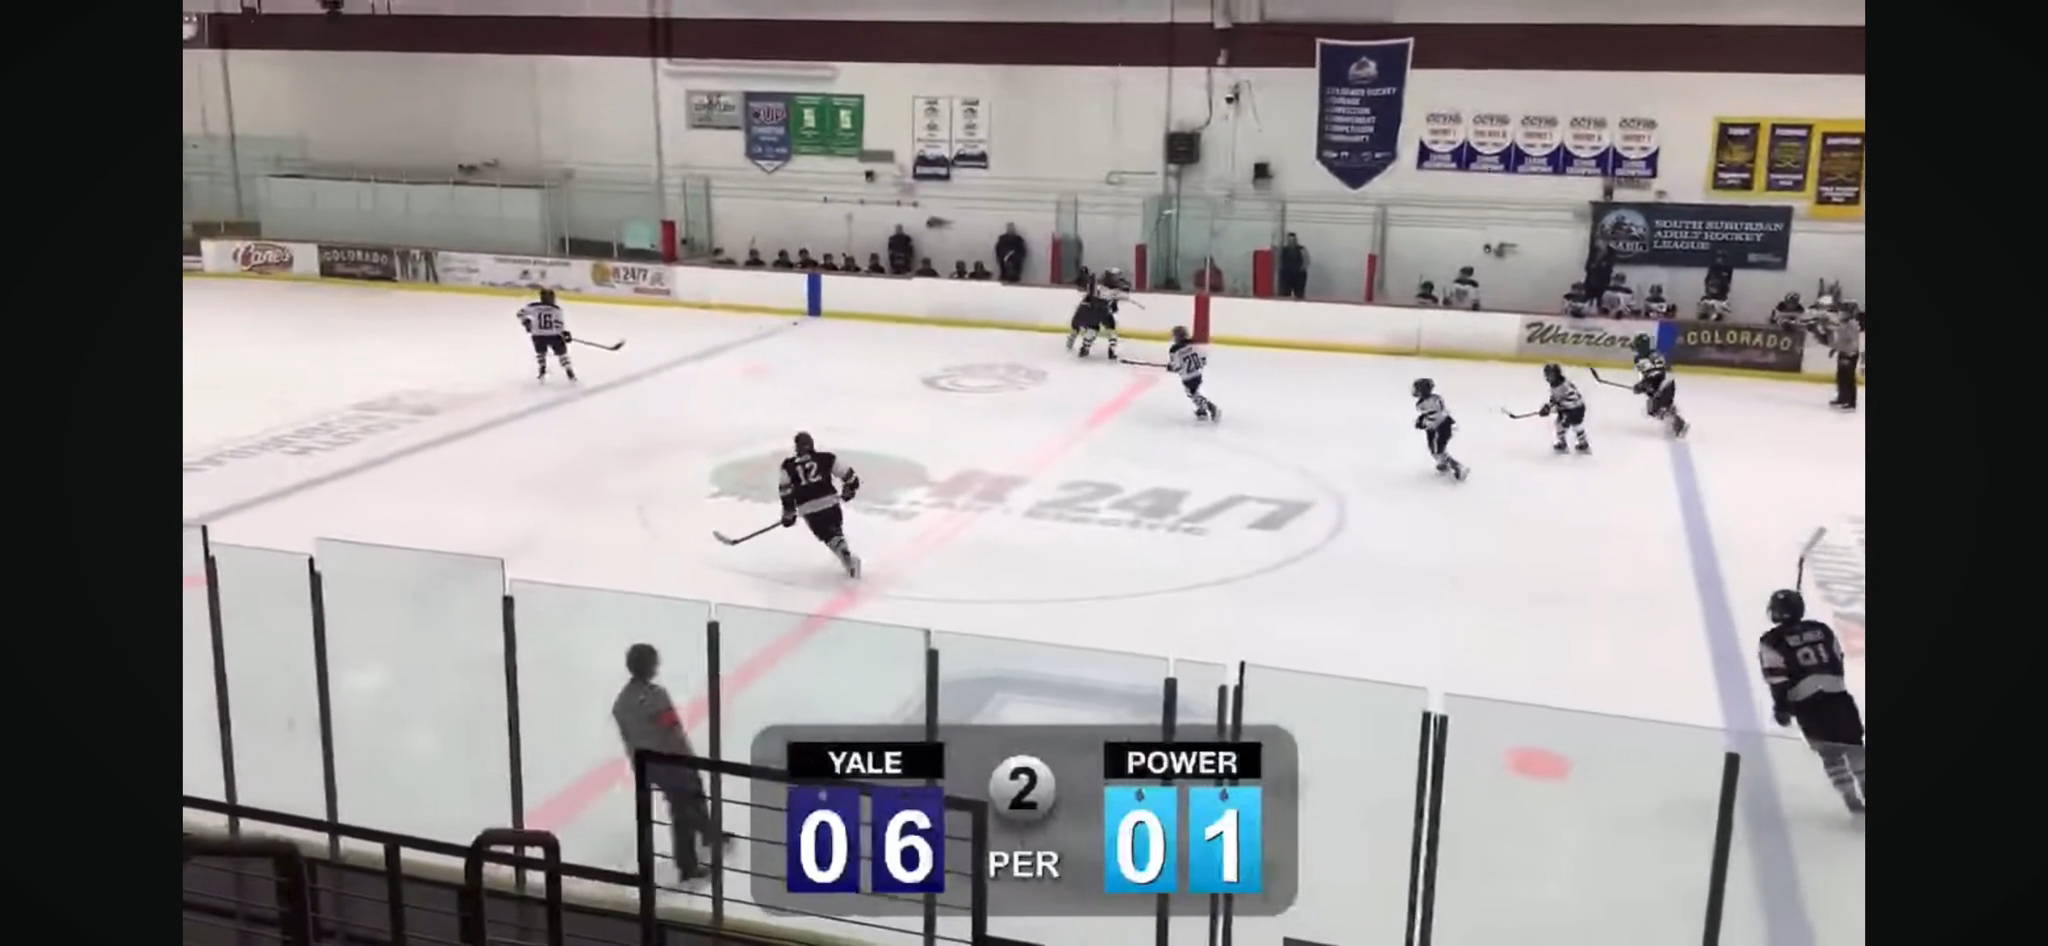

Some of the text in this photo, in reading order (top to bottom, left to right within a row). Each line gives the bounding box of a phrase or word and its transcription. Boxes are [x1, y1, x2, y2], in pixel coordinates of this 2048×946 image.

[1655, 219, 1784, 232] SOUTH SUBURBAN
[1654, 230, 1764, 243] ADULT HOCKEY
[1653, 240, 1710, 250] LEAGUE
[324, 249, 389, 264] COLORADO
[537, 313, 554, 330] 16
[1687, 330, 1793, 352] COLORADO
[1183, 352, 1201, 373] 20
[796, 461, 822, 485] 12
